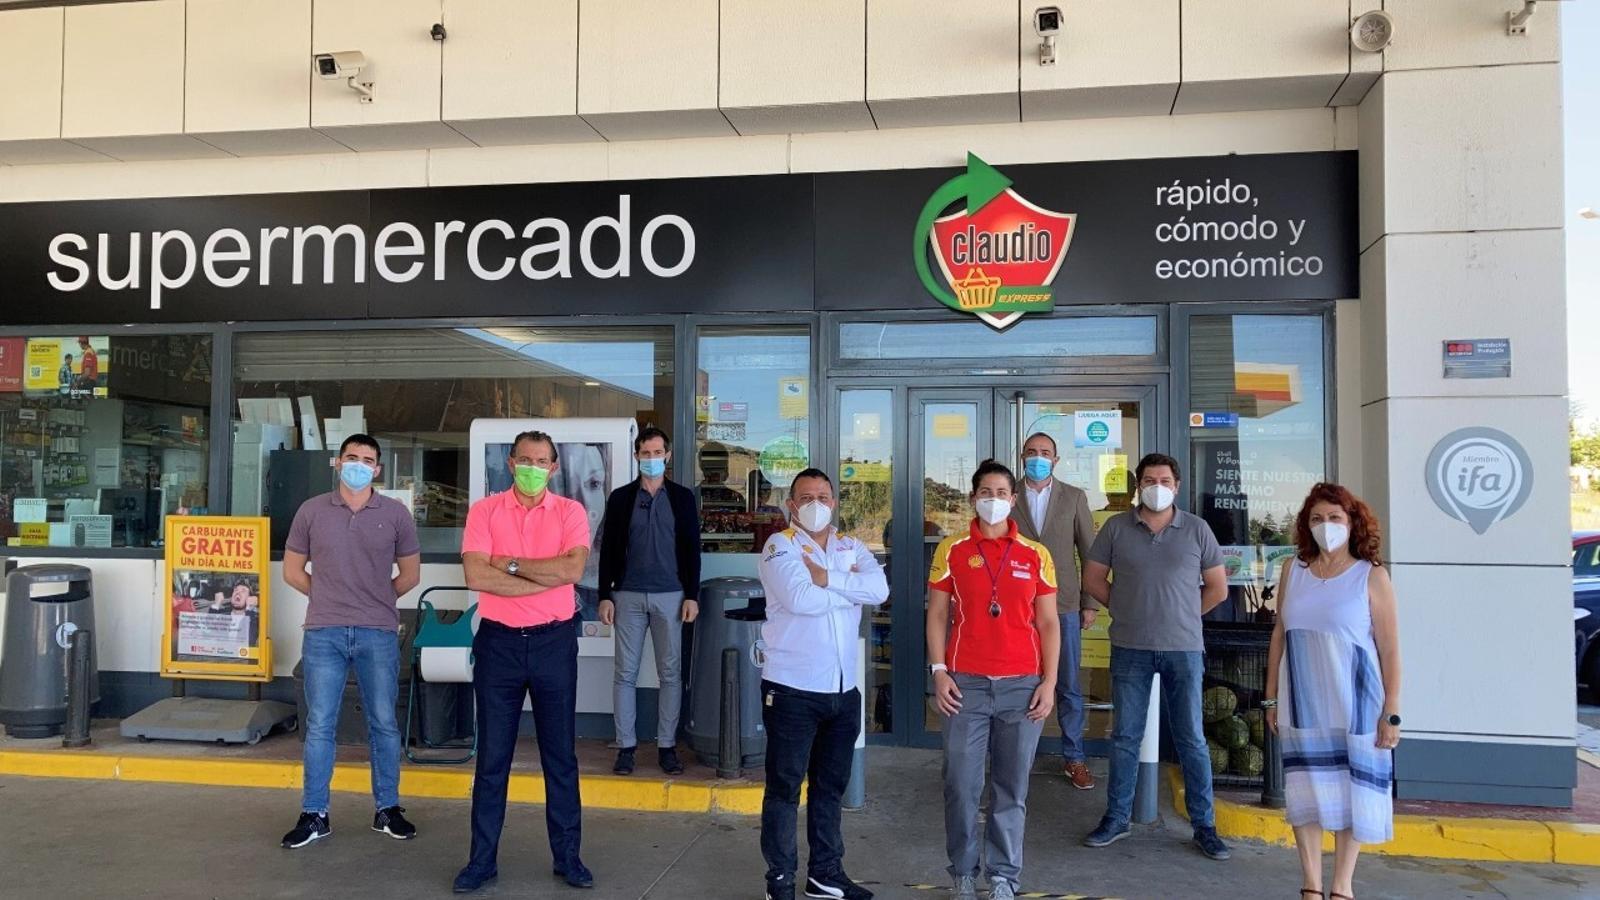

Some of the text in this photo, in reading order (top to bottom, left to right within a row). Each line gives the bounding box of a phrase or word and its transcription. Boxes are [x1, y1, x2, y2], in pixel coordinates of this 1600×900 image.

[1156, 178, 1259, 212] rápido,
[1155, 214, 1307, 246] cómodo y
[46, 194, 697, 309] supermercado
[951, 222, 1053, 266] claudio
[1155, 250, 1324, 280] económico
[1462, 455, 1499, 463] Miembro
[1215, 468, 1325, 483] SIENTE NUESTRO
[1457, 465, 1502, 496] ifa
[1215, 480, 1274, 497] MÁXIMO
[182, 525, 255, 538] CARBURANTE
[181, 537, 254, 558] GRATIS
[181, 557, 253, 569] UN DÍA AL MES
